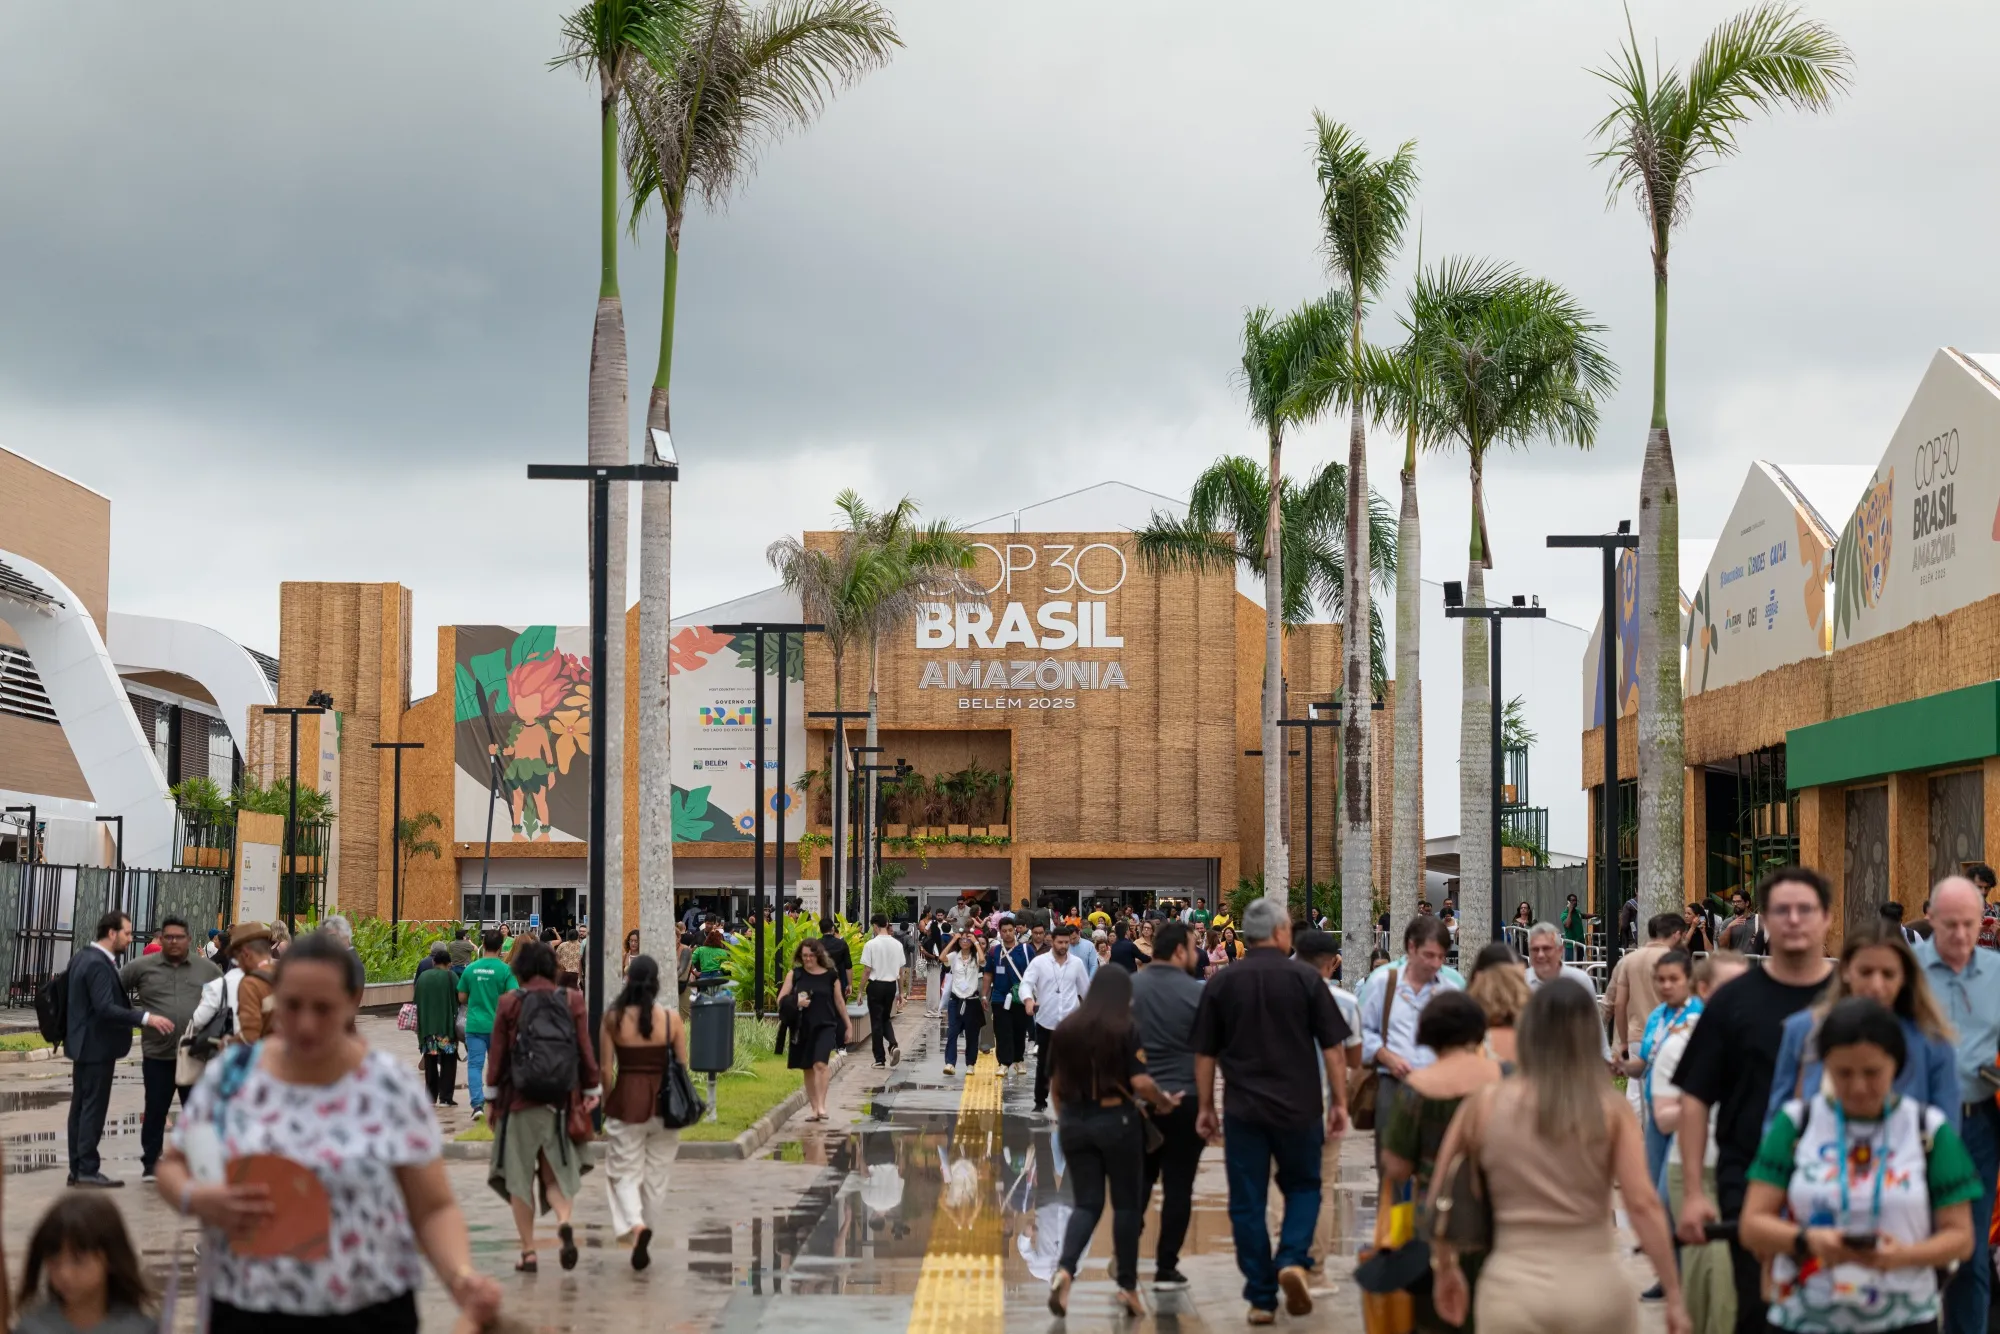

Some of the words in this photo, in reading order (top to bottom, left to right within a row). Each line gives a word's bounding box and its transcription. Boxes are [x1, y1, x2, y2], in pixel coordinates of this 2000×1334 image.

[1914, 428, 1960, 490] COP30
[1913, 482, 1957, 541] BRASIL
[1770, 540, 1787, 566] CAIXA
[1912, 532, 1957, 573] AMAZÔNIA
[916, 600, 1124, 650] BRASIL
[918, 656, 1129, 690] AMAZÔNIA
[958, 695, 1022, 709] BELÉM
[1028, 698, 1076, 709] 2025
[704, 759, 728, 767] BELÉM
